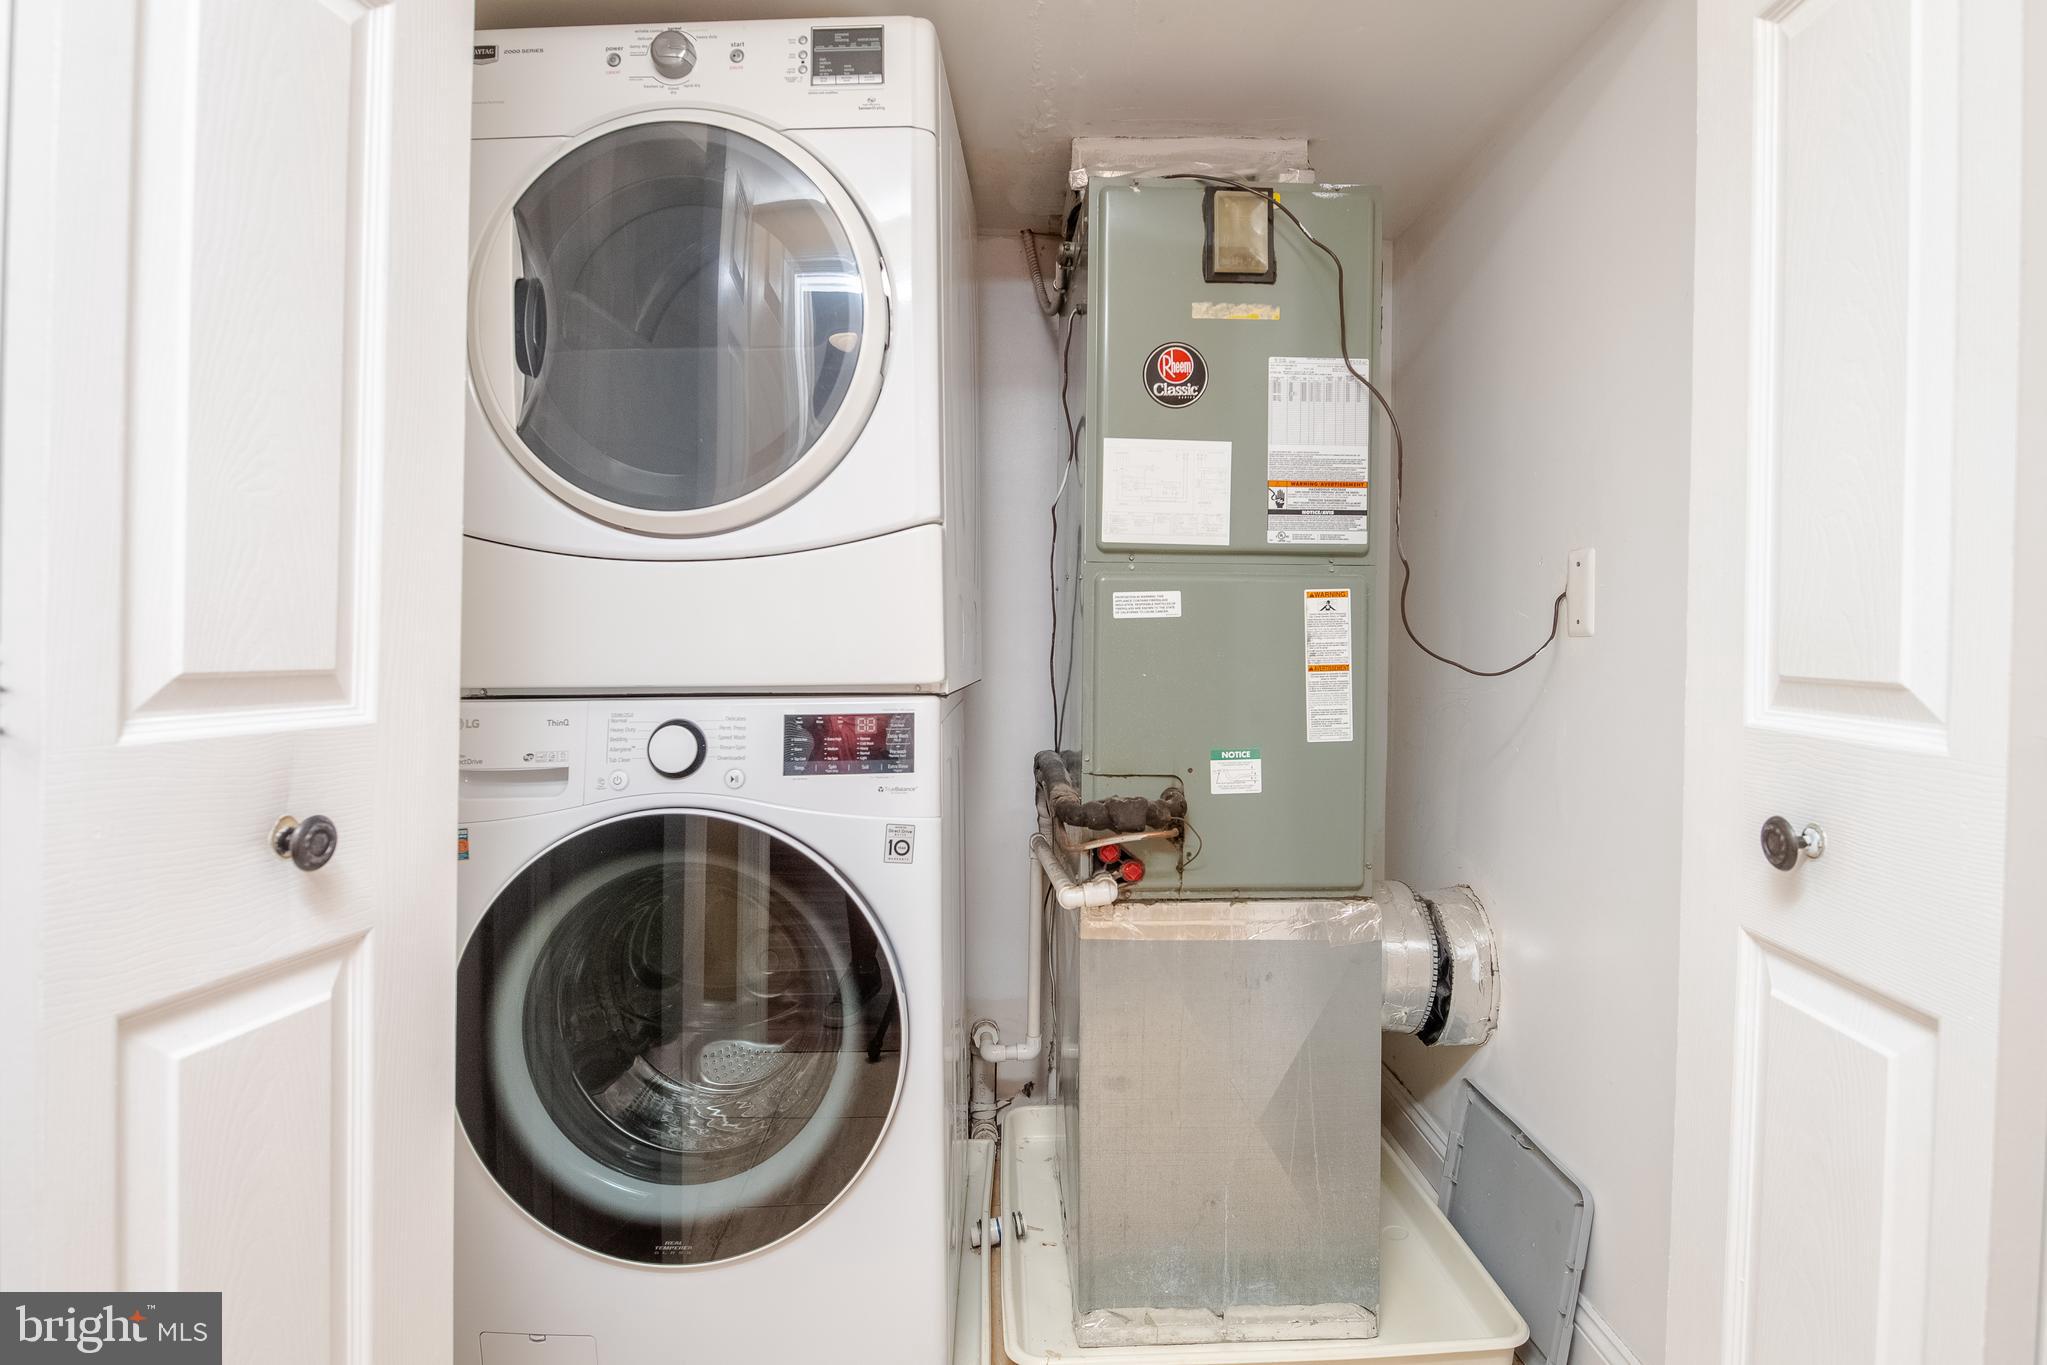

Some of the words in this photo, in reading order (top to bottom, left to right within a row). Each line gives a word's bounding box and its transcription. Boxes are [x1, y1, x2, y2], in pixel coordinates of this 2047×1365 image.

[1162, 349, 1193, 378] Rheem
[1153, 382, 1199, 396] Classic
[465, 719, 480, 729] LG
[547, 719, 569, 727] ThinQ
[1221, 750, 1251, 758] NOTICE
[888, 839, 910, 856] 10
